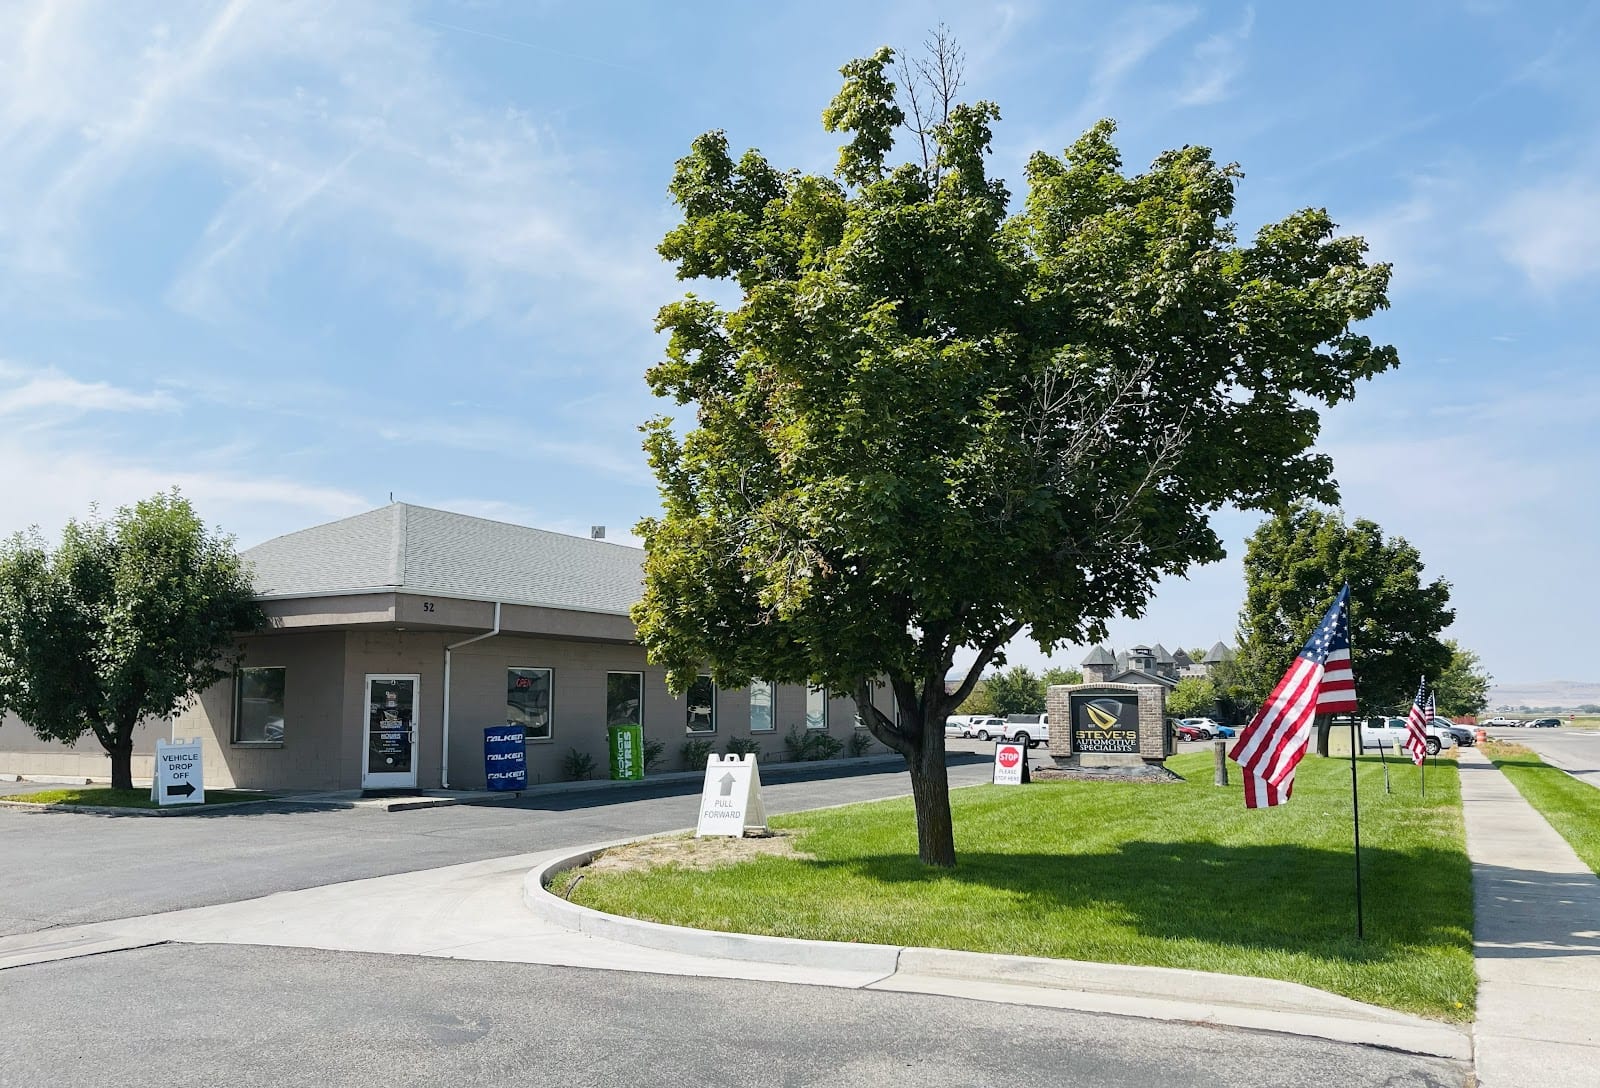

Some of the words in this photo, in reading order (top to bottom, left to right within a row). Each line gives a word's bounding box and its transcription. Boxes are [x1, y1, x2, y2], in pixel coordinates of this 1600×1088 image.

[423, 602, 435, 612] 52
[1075, 730, 1136, 739] STEVE'S
[1076, 738, 1136, 746] AUTOMOTIVE
[162, 753, 198, 762] VEHICLE
[624, 731, 633, 778] TYRES
[999, 752, 1018, 761] STOP
[169, 763, 193, 771] DROP
[714, 799, 733, 808] PULL
[703, 811, 741, 819] FORWARD
